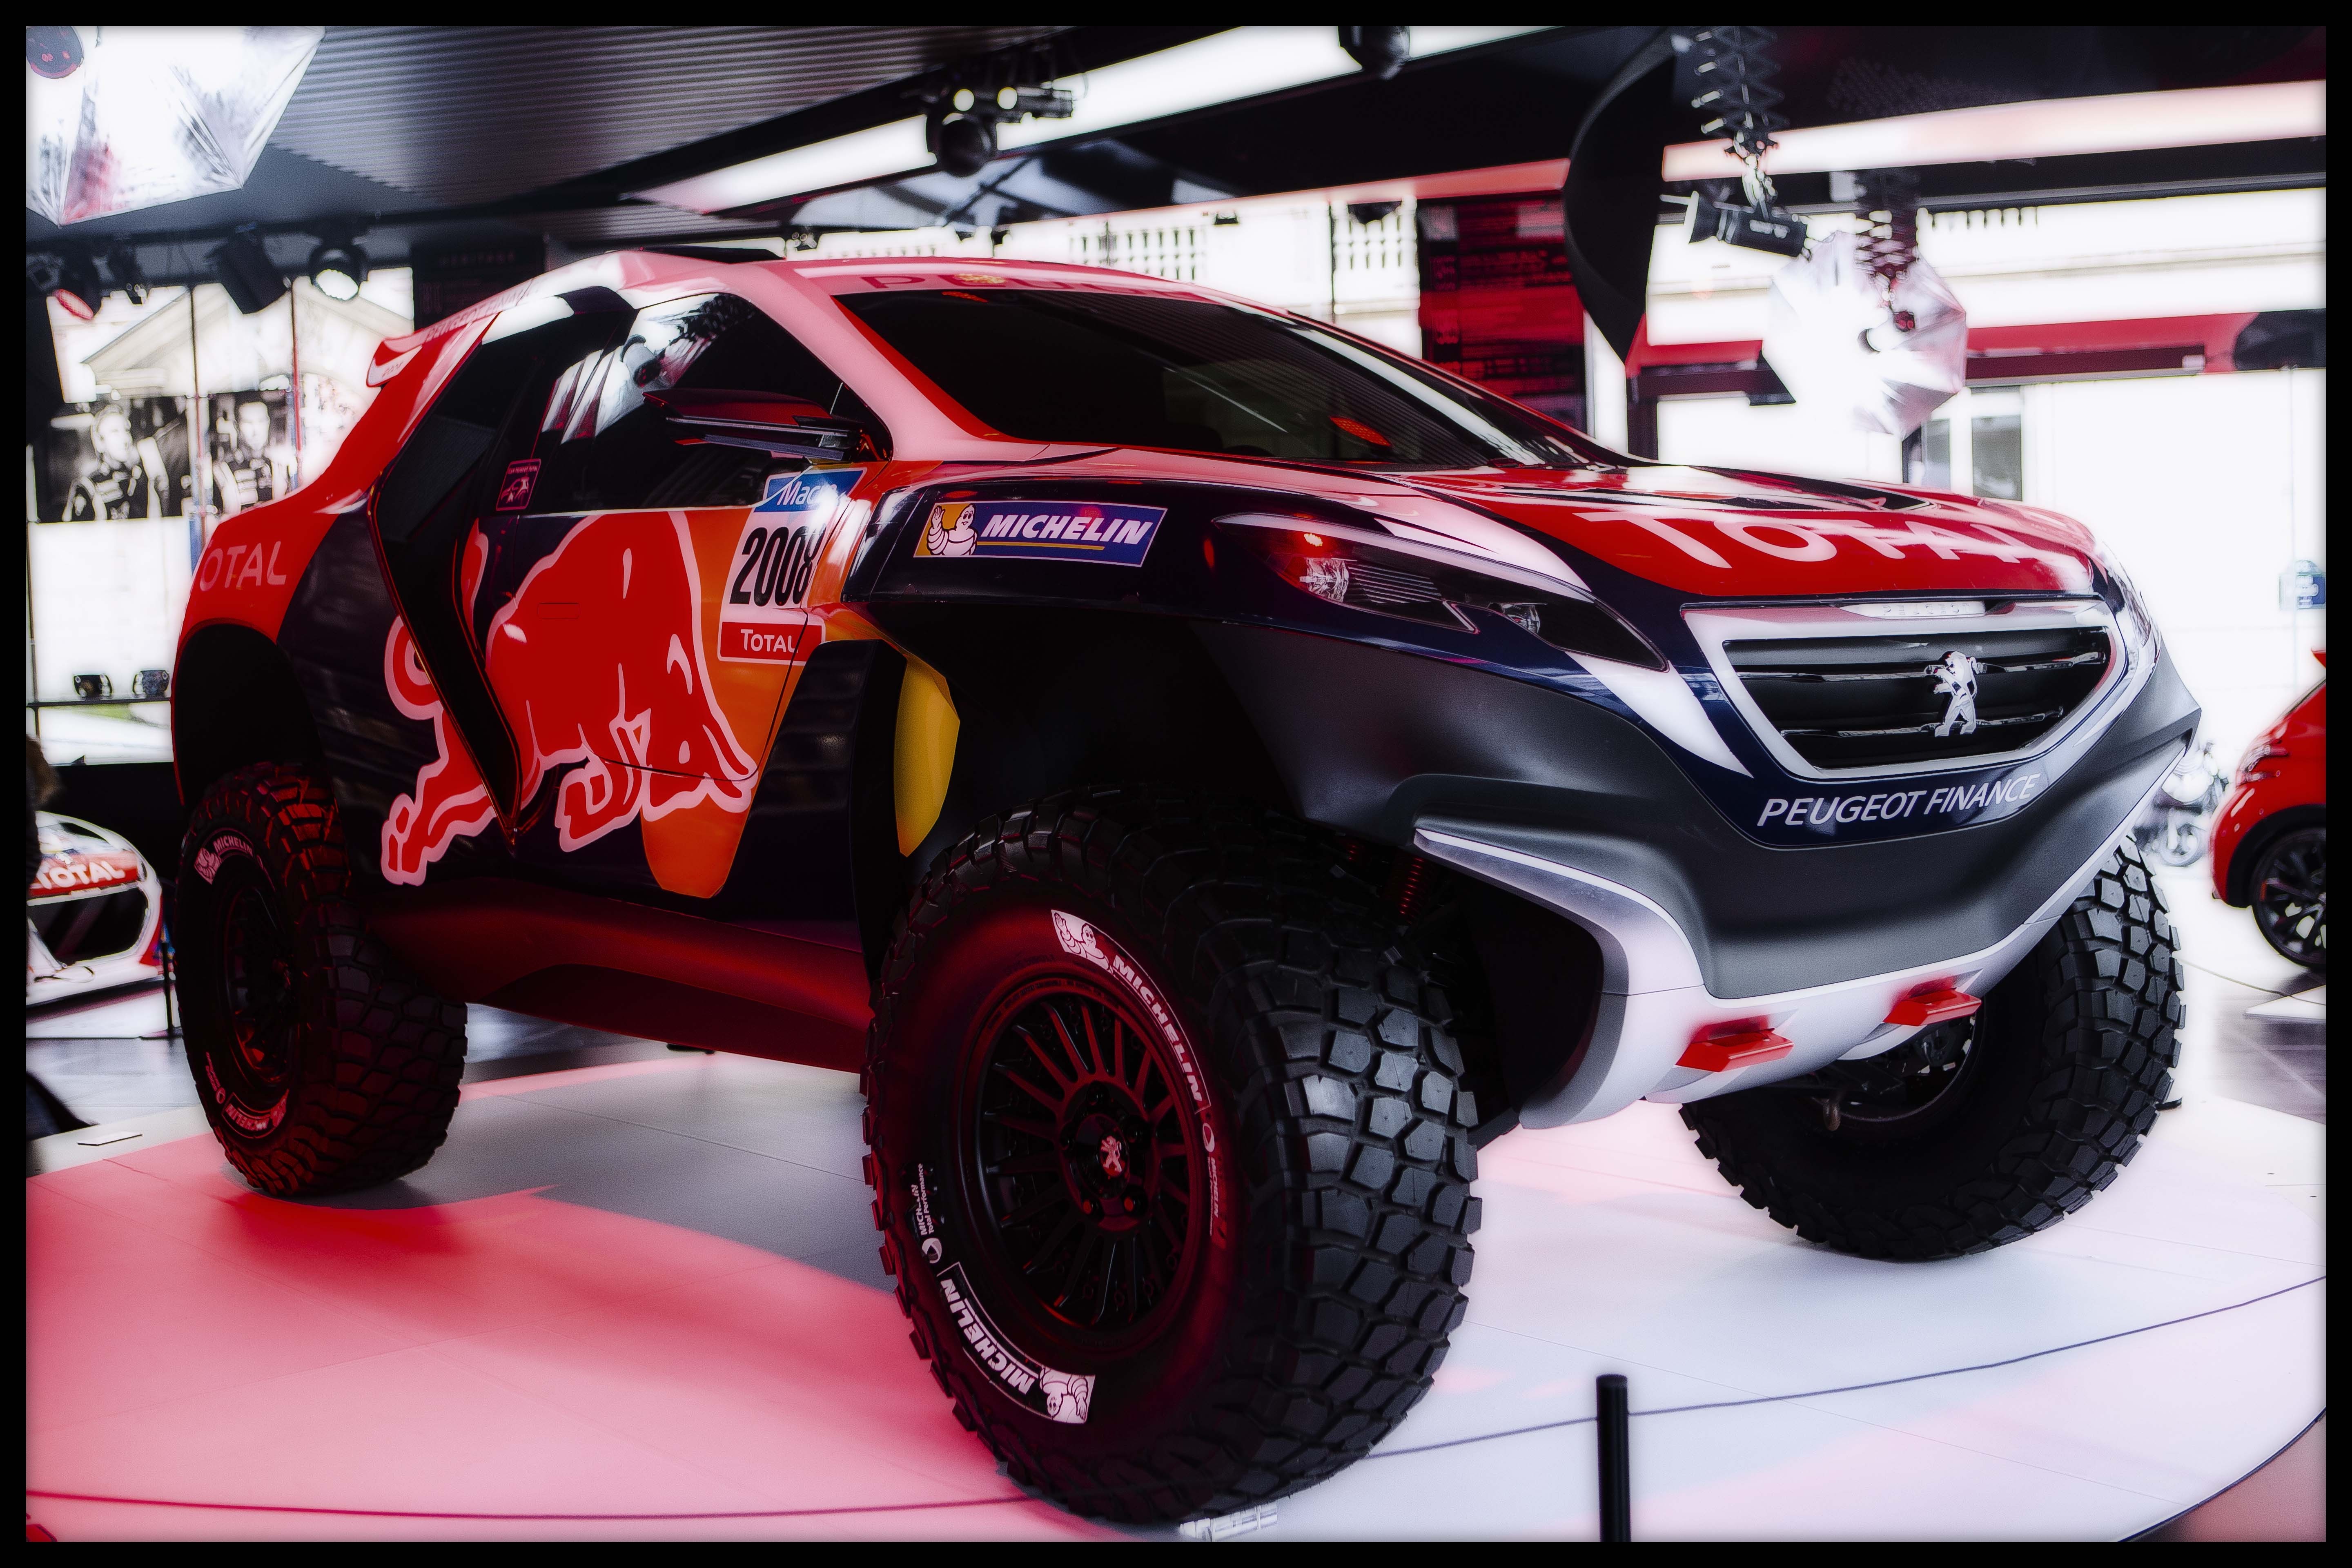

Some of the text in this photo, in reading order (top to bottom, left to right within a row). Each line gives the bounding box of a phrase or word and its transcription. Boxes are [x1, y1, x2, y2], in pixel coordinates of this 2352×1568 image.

[980, 515, 1153, 544] MICHELIN
[199, 540, 287, 592] OTAL
[729, 523, 826, 607] 2008
[740, 629, 798, 653] TOTAL
[1757, 773, 2041, 826] PEUGEOT FINANCE
[212, 835, 254, 858] MICHELIN
[36, 860, 126, 890] TOTAL
[1112, 955, 1202, 1102] MICHELIN
[918, 1163, 934, 1235] Total Performance
[940, 1278, 1039, 1395] MICHELIN
